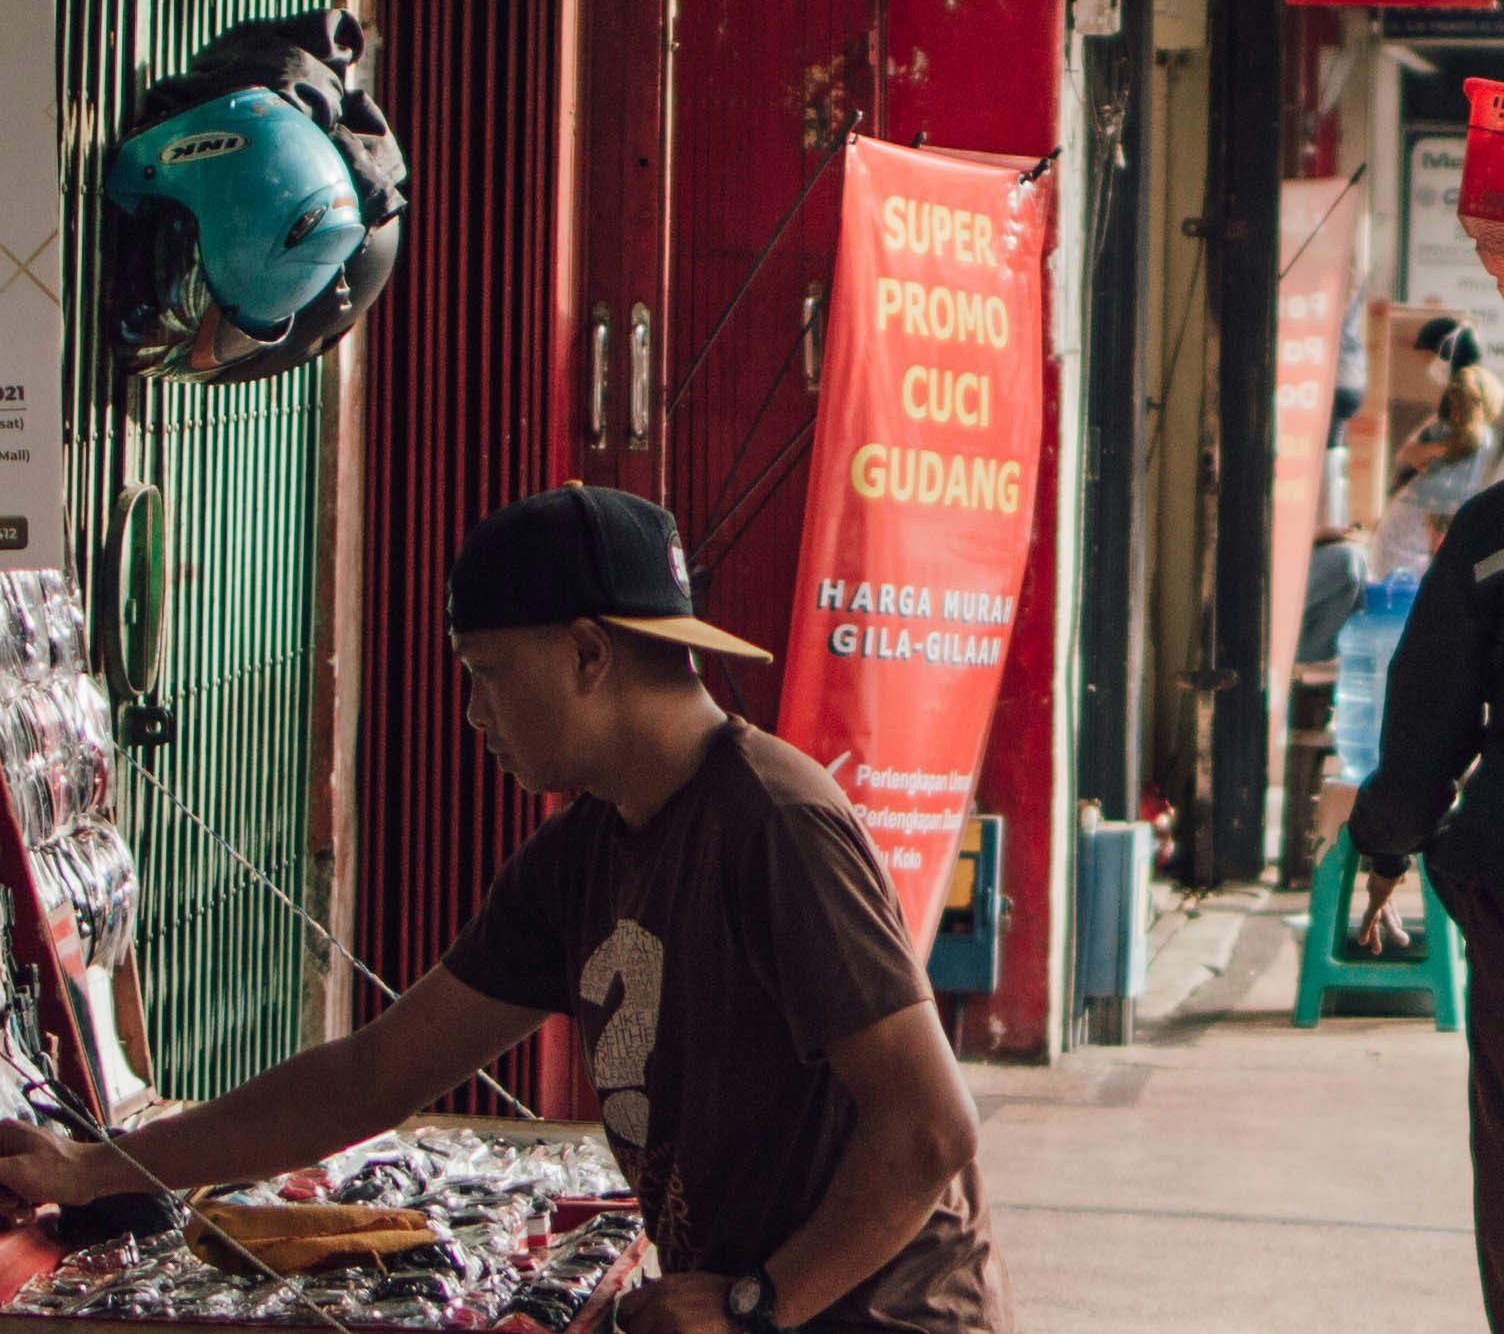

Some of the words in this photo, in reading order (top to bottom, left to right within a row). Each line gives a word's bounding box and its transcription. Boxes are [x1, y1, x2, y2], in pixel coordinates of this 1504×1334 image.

[169, 136, 240, 160] INK
[882, 194, 998, 269] SUPER
[876, 276, 1009, 350] PROMO
[901, 363, 991, 429] CUCI
[849, 441, 1021, 516] GUDANG
[818, 578, 932, 619] HARGA
[944, 586, 1013, 628] MURAH
[828, 623, 1003, 670] GILA-GILAAN
[856, 764, 947, 795] Perlengkapan
[853, 804, 942, 835] Perlengkapan
